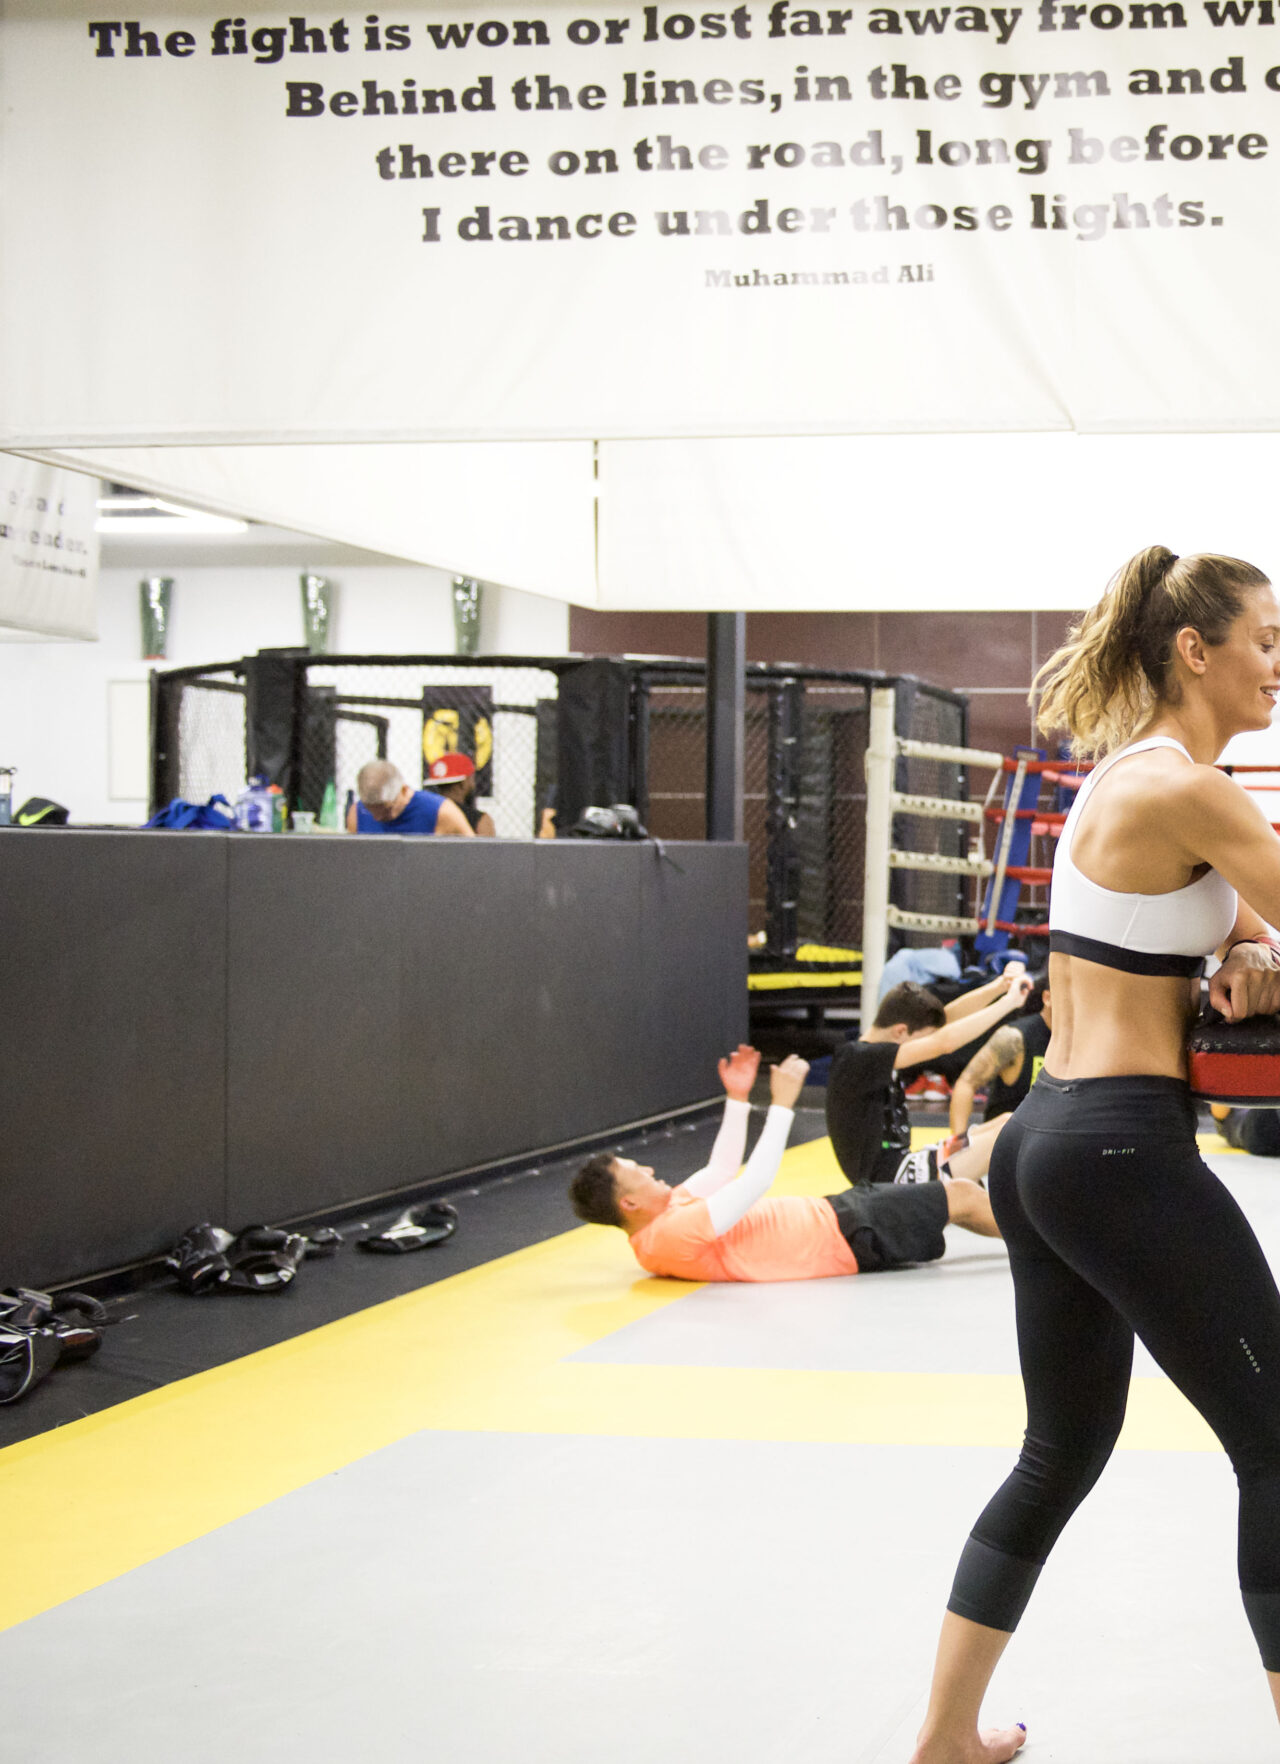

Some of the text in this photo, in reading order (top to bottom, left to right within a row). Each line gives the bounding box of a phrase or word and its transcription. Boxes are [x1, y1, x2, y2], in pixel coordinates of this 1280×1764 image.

[88, 21, 196, 57] The
[211, 17, 349, 64] fight
[364, 14, 411, 51] is
[427, 20, 550, 50] won
[567, 18, 630, 45] or
[643, 4, 751, 42] lost
[768, 0, 853, 38] far
[868, 6, 1022, 45] away
[1038, 0, 1187, 31] from
[285, 76, 496, 117] Behind
[511, 75, 607, 111] the
[623, 70, 782, 113] lines,
[794, 65, 852, 101] in
[868, 64, 961, 100] the
[979, 71, 1110, 110] gym
[1128, 56, 1247, 95] and
[375, 123, 1269, 181] there on the road, long before
[422, 192, 1224, 243] I dance under those lights.
[704, 263, 935, 288] Muhammad Ali
